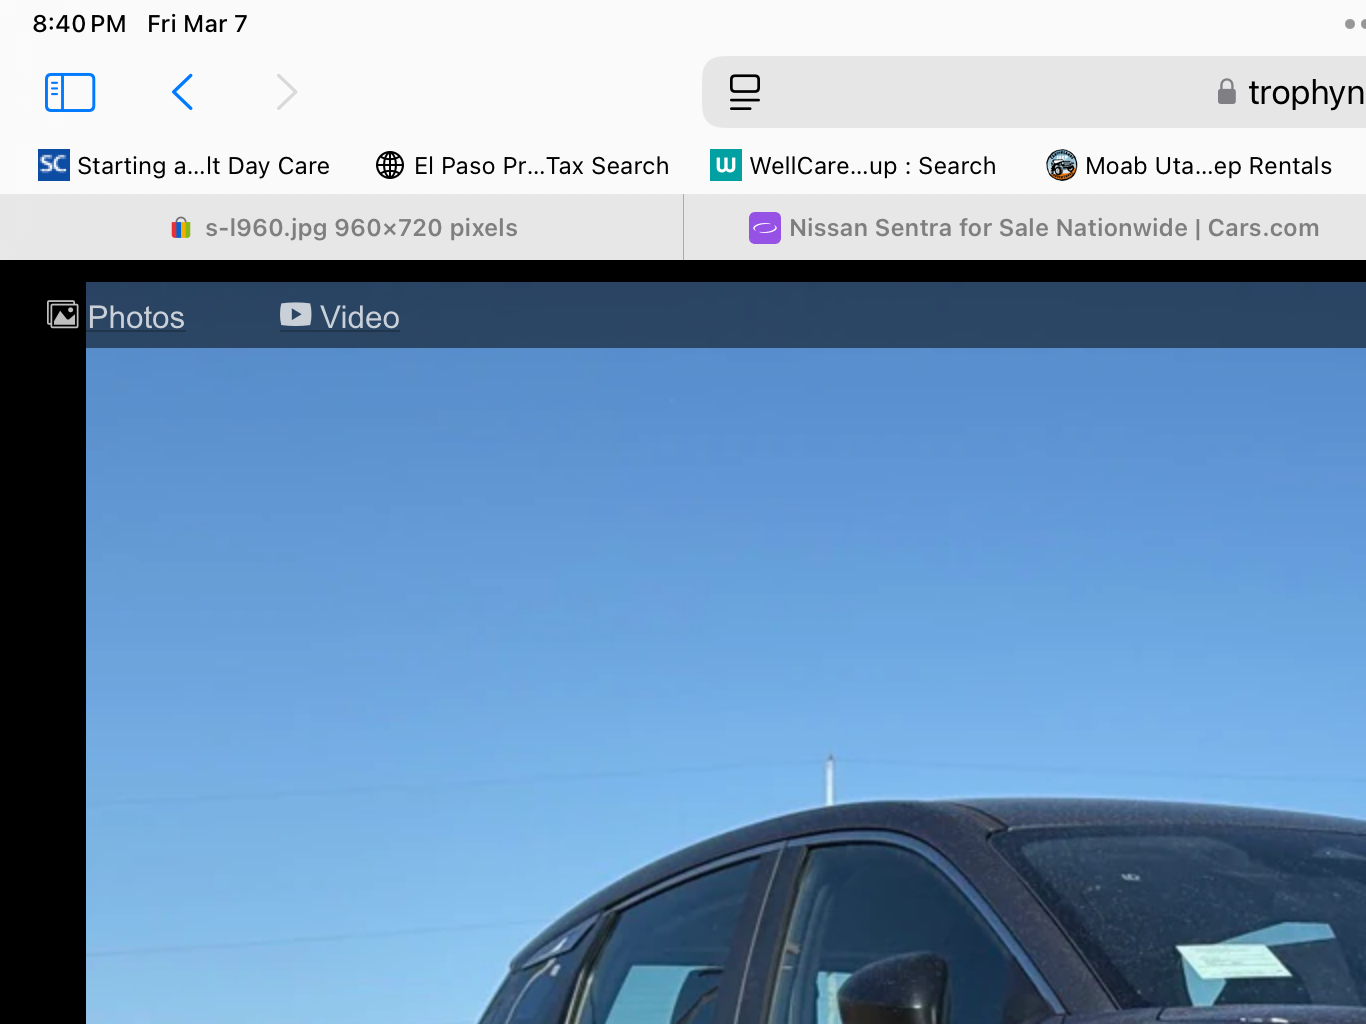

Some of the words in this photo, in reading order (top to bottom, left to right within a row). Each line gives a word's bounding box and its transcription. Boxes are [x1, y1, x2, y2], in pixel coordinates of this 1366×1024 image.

[148, 13, 176, 33] Fri
[184, 14, 228, 33] Mar
[234, 14, 248, 33] 7
[77, 155, 166, 180] Starting
[228, 156, 271, 180] Day
[278, 155, 330, 176] Care
[415, 155, 433, 175] El
[442, 156, 496, 176] Paso
[591, 155, 669, 176] Search
[918, 155, 996, 176] Search
[1086, 155, 1148, 176] Moab
[1249, 155, 1333, 176] Rentals
[450, 217, 518, 241] pixels
[790, 217, 868, 237] Nissan
[875, 218, 952, 238] Sentra
[958, 217, 993, 237] for
[999, 217, 1049, 238] Sale
[1056, 217, 1188, 237] Nationwide
[1208, 218, 1319, 238] Cars.com
[88, 304, 186, 330] Photos
[319, 304, 401, 330] Video
